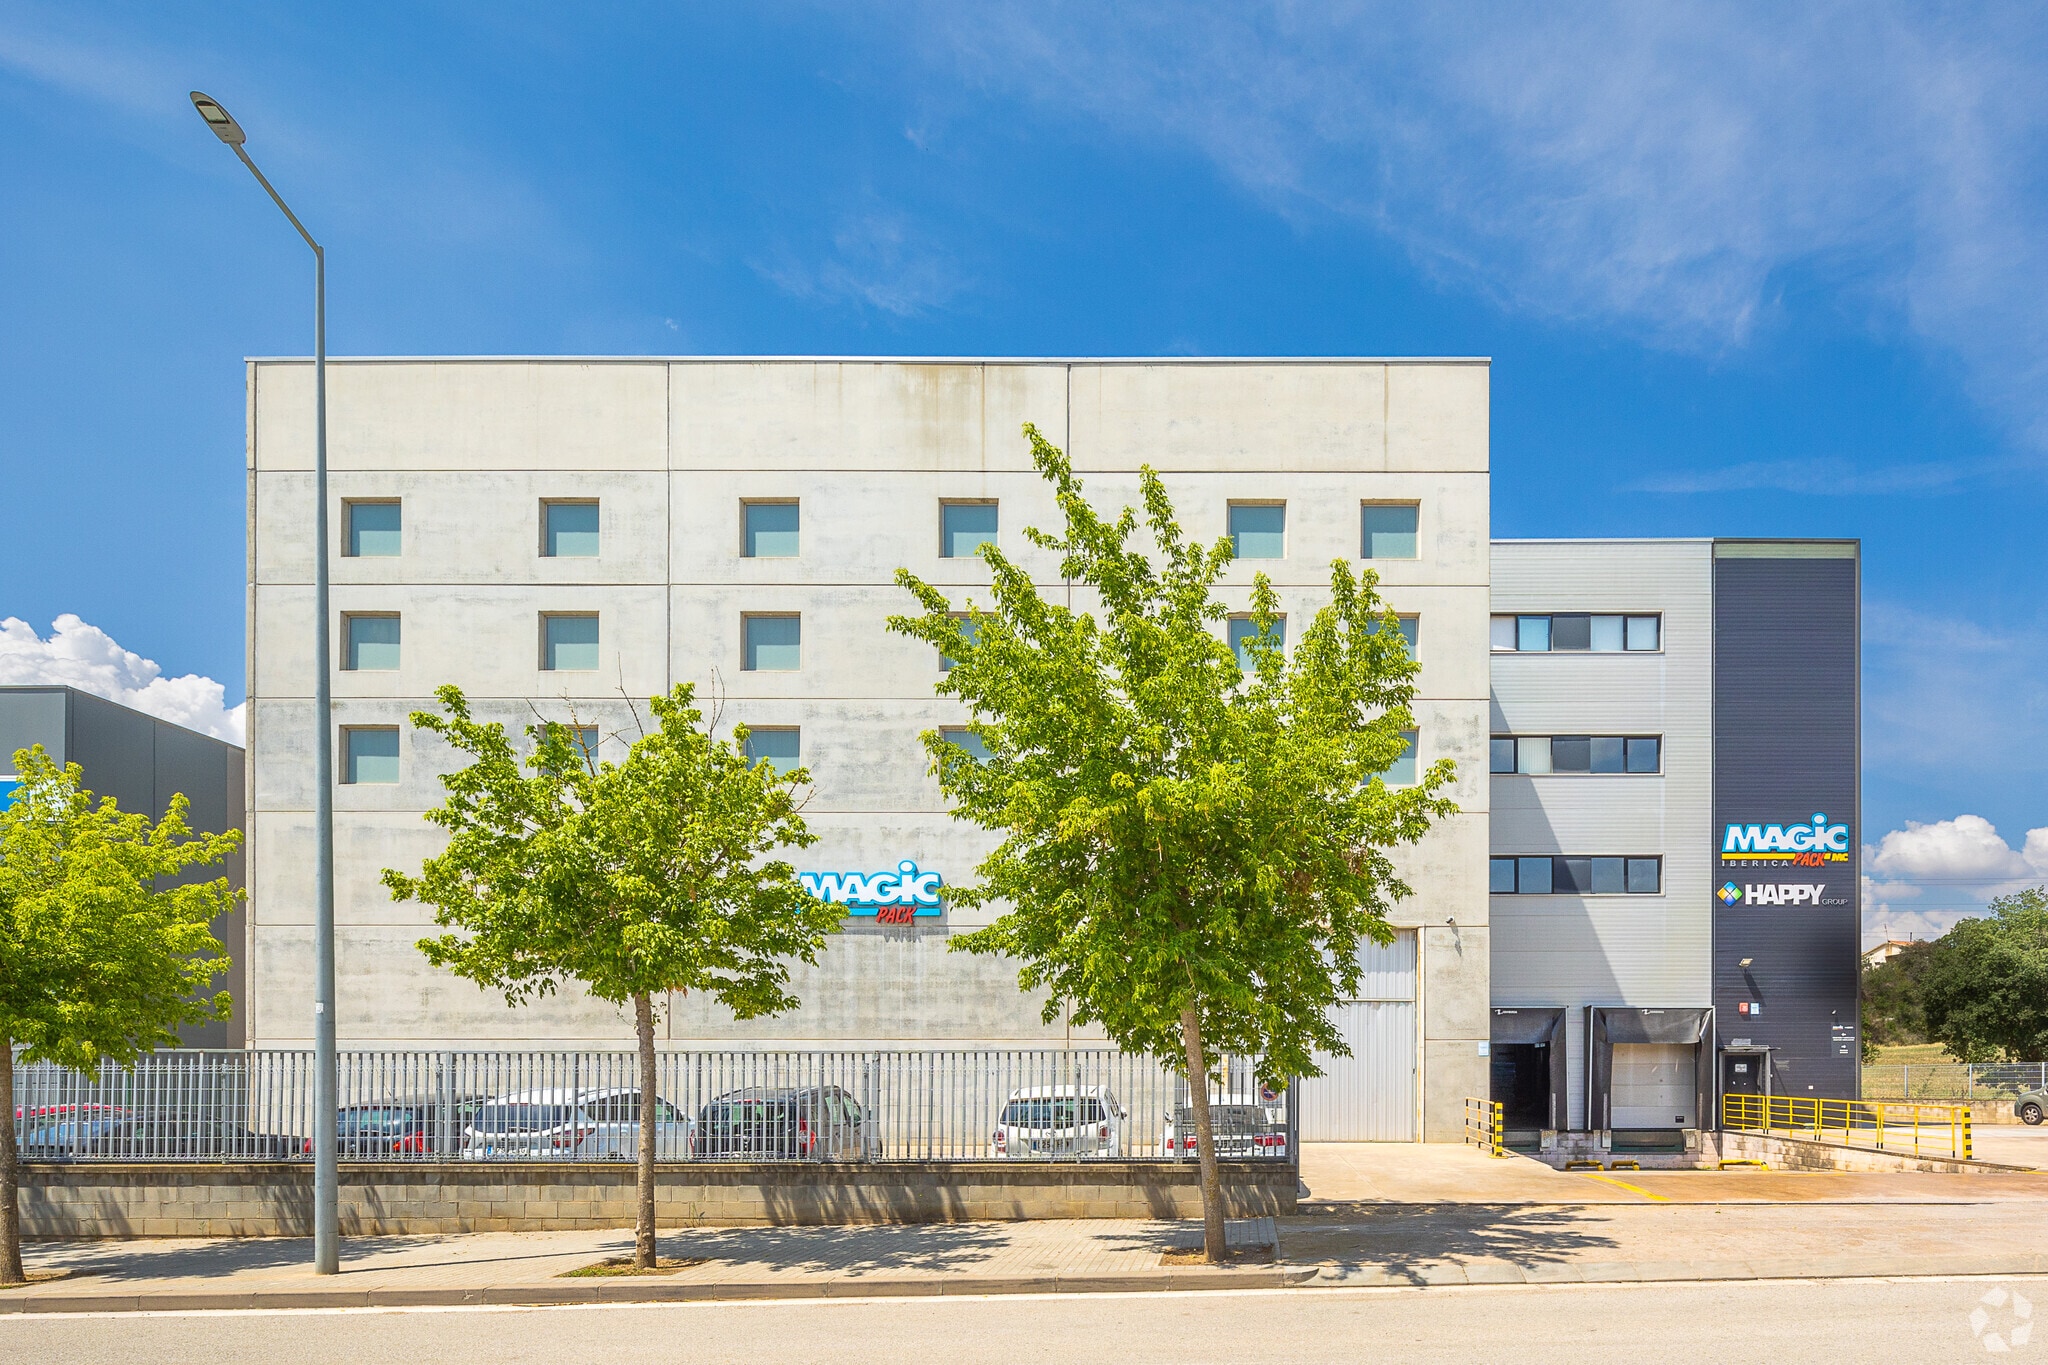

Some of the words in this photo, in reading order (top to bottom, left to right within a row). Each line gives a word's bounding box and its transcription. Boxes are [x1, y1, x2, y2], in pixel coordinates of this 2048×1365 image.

[1792, 852, 1825, 867] PACK
[1831, 852, 1849, 862] MC
[1745, 884, 1826, 905] HAPPY
[876, 906, 917, 924] PACK
